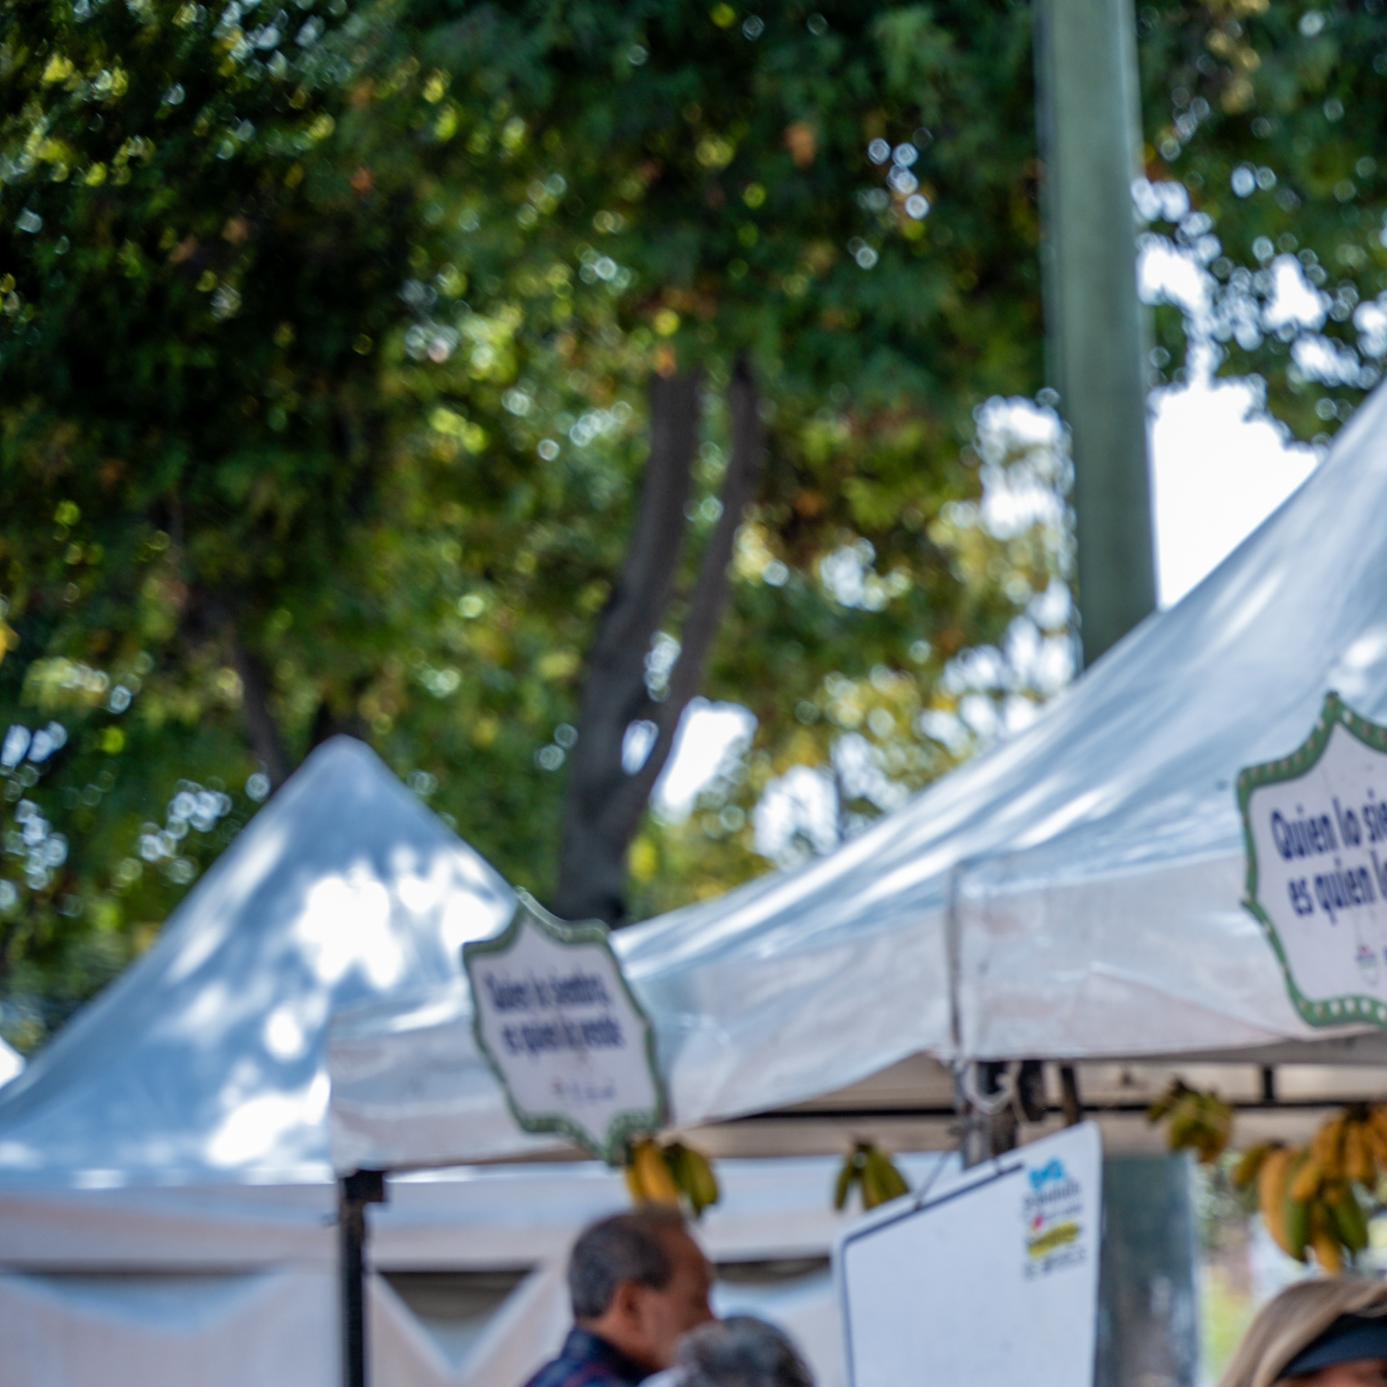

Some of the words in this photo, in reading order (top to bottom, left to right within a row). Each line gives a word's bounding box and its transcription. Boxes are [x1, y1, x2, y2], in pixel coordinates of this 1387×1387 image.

[1271, 805, 1338, 861] Quien
[1333, 797, 1362, 847] lo
[1288, 876, 1314, 917] es
[1314, 857, 1374, 926] quien
